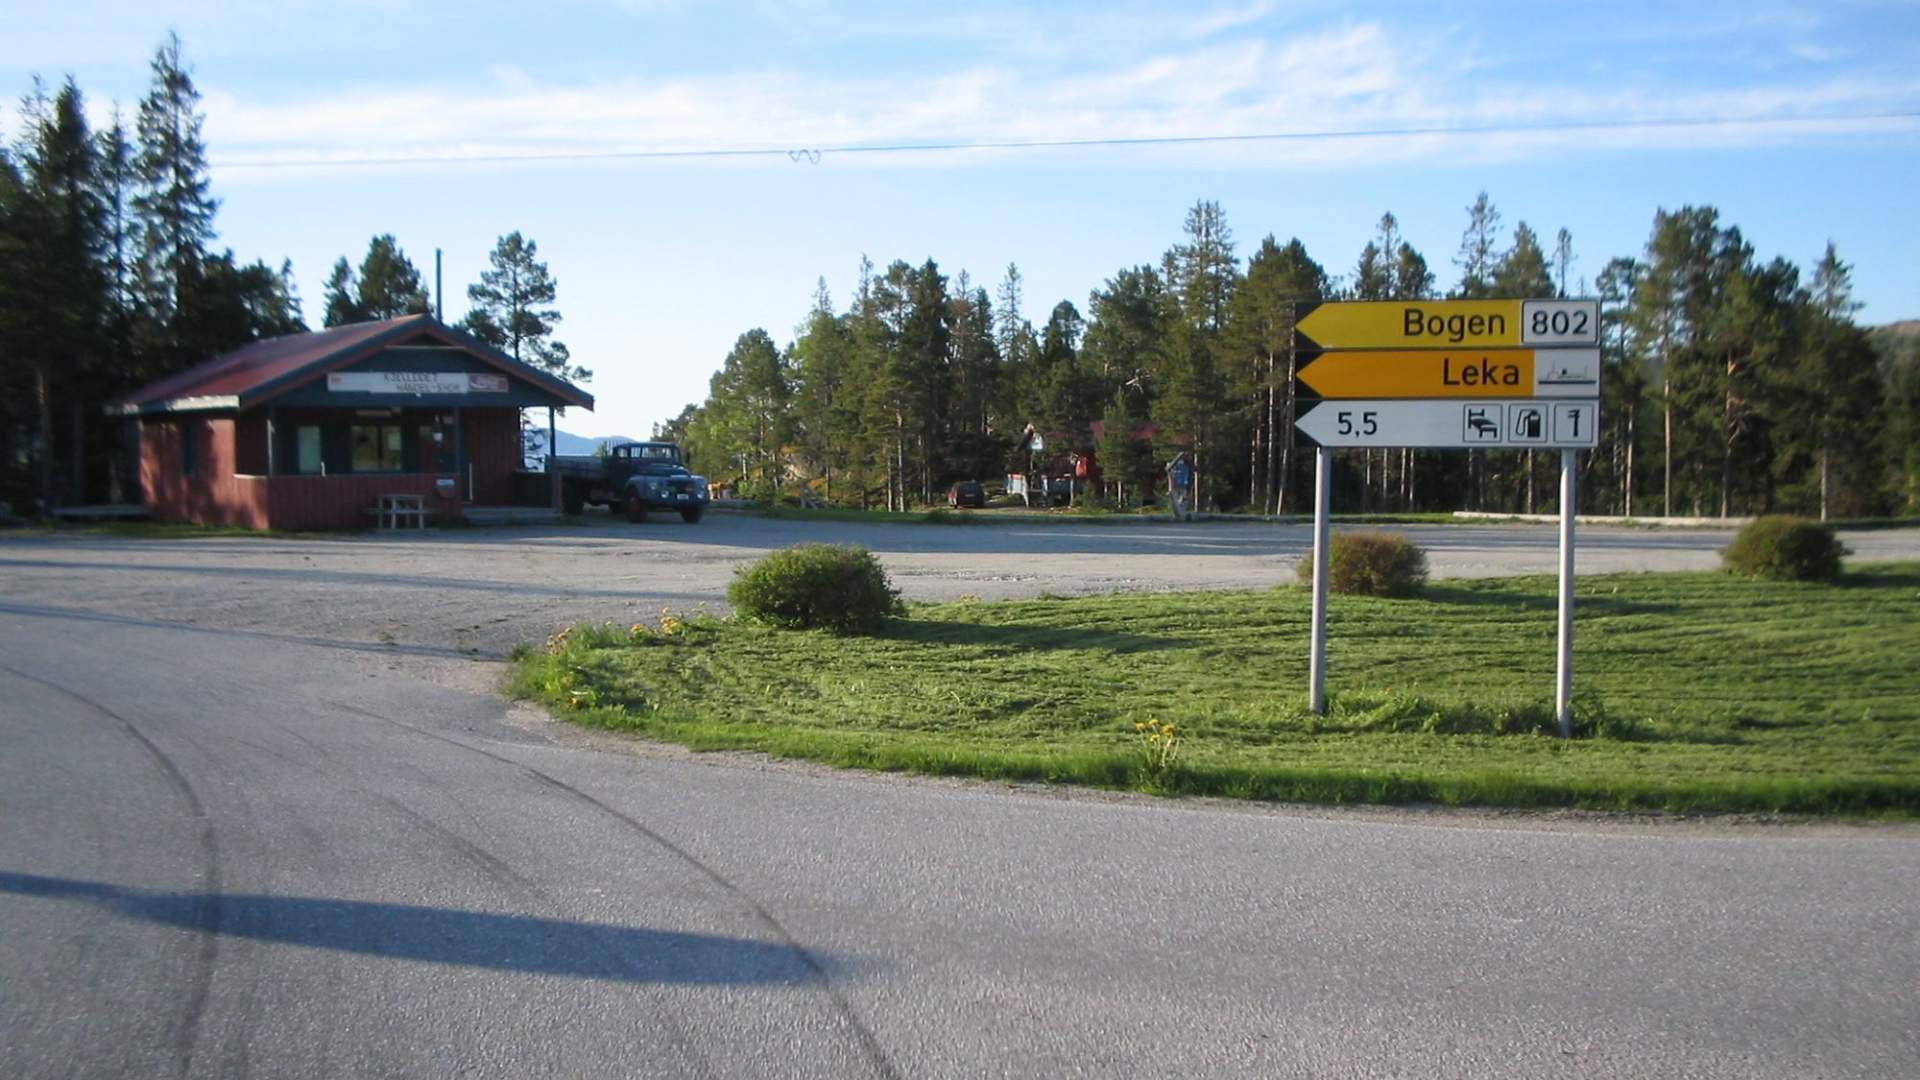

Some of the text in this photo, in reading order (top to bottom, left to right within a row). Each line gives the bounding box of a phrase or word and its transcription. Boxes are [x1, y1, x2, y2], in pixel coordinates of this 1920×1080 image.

[1403, 308, 1506, 343] Bogen
[1531, 310, 1589, 336] 802
[1442, 357, 1520, 387] Leka
[1337, 411, 1379, 438] 5,5
